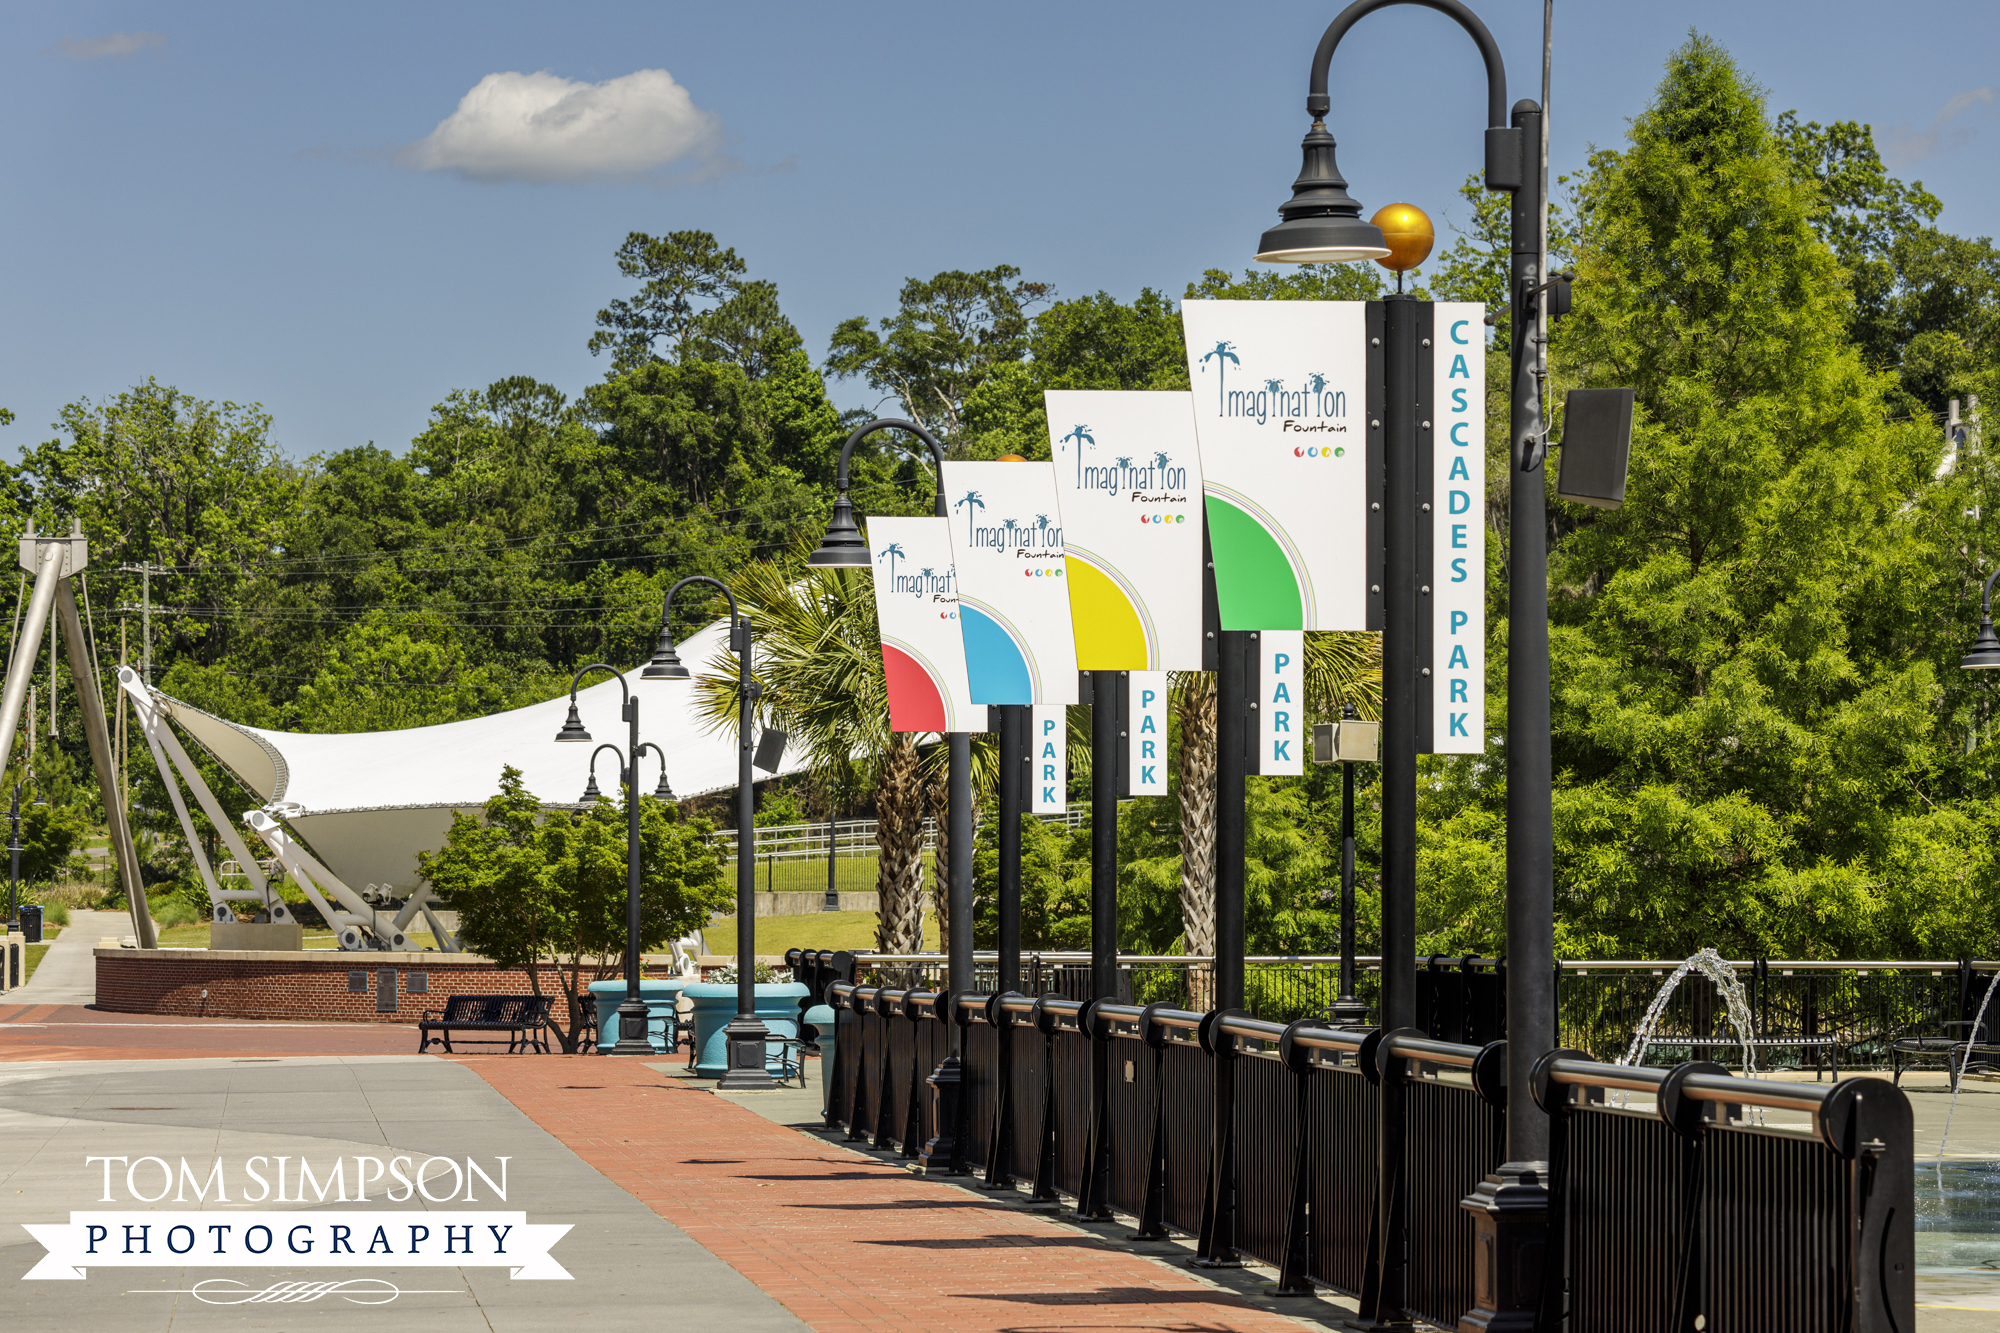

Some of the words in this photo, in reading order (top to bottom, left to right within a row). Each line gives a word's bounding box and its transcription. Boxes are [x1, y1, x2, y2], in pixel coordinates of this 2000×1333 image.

[1199, 340, 1346, 425] Imagination
[1059, 424, 1186, 496] Imagination
[1283, 420, 1347, 433] Fountain
[1448, 320, 1471, 583] CASCADES
[1131, 491, 1187, 503] Fountain
[878, 543, 957, 598] Imaginat
[1016, 549, 1065, 559] Fountain
[933, 594, 959, 603] Foun
[1272, 653, 1291, 761] PARK
[1447, 610, 1470, 737] PARK
[1042, 719, 1056, 803] PARK
[1140, 689, 1156, 784] PARK
